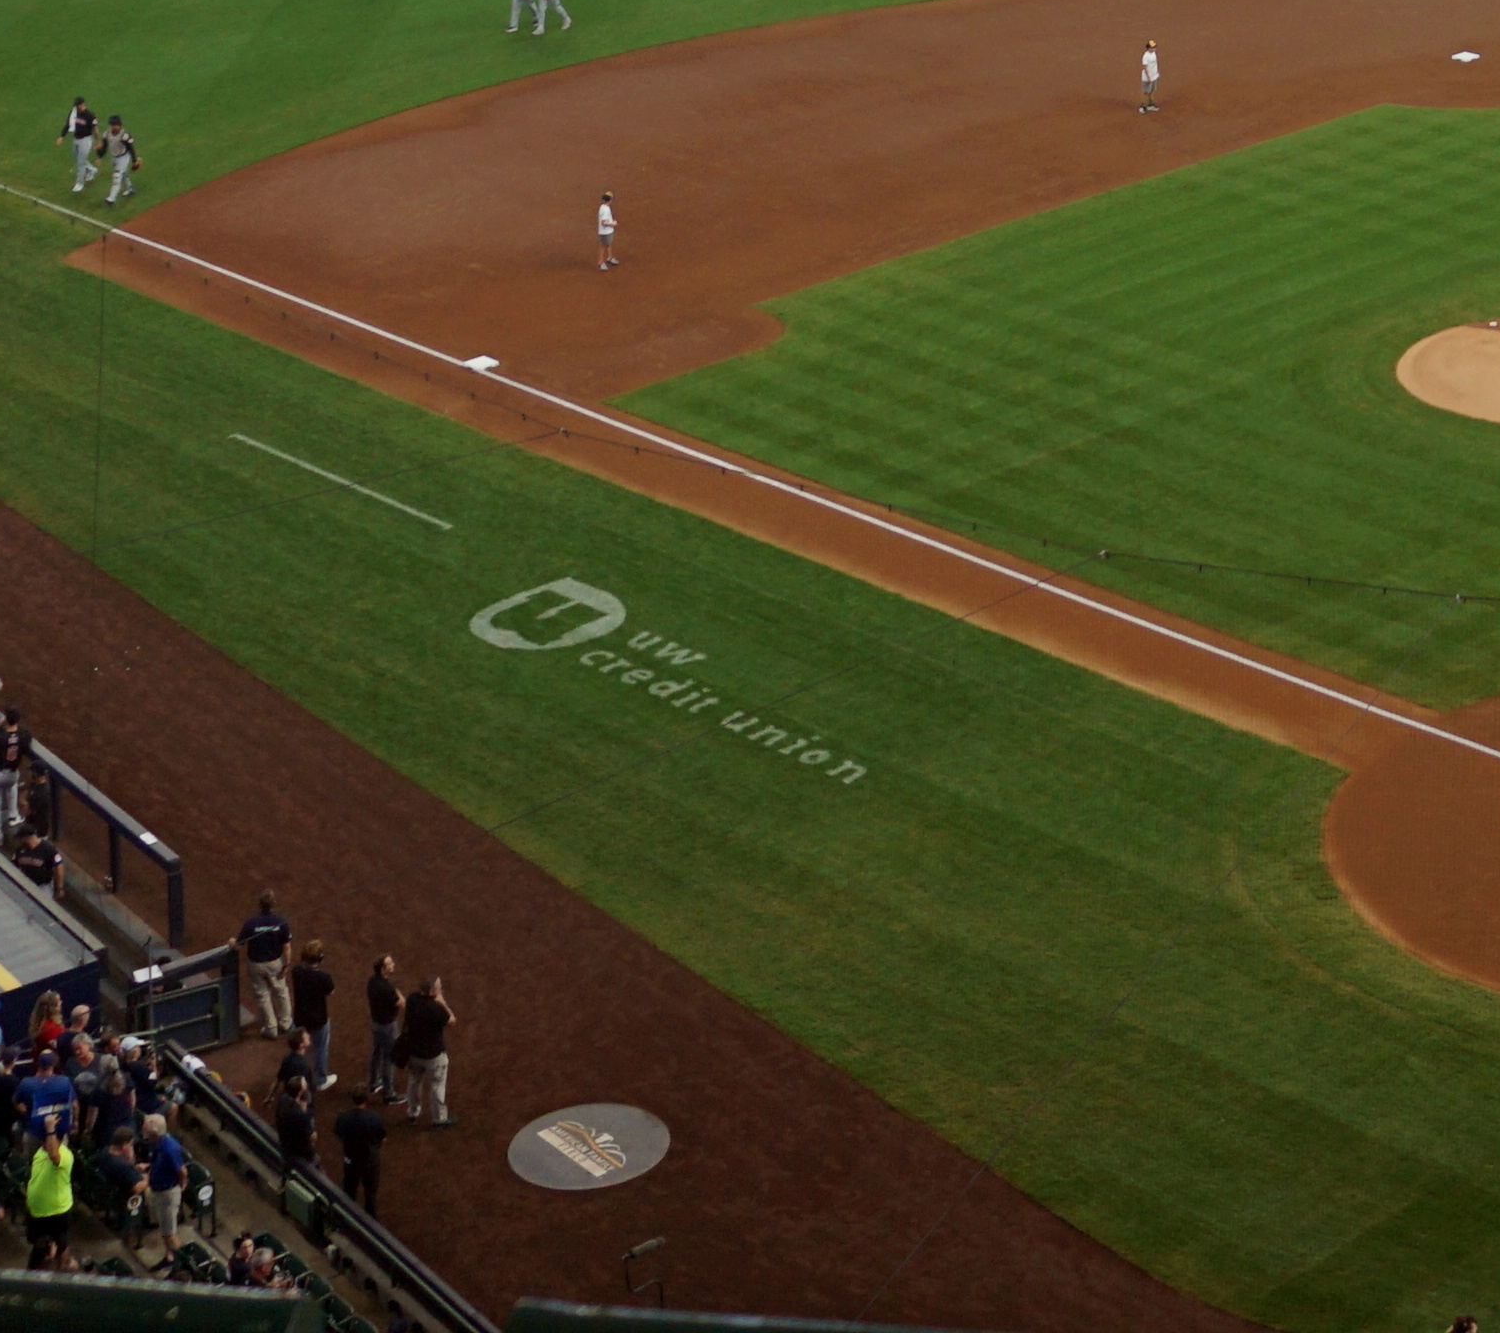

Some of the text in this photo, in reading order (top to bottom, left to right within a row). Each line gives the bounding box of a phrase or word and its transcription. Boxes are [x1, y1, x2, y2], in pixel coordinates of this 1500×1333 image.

[626, 630, 707, 667] uw
[579, 648, 868, 785] credit union
